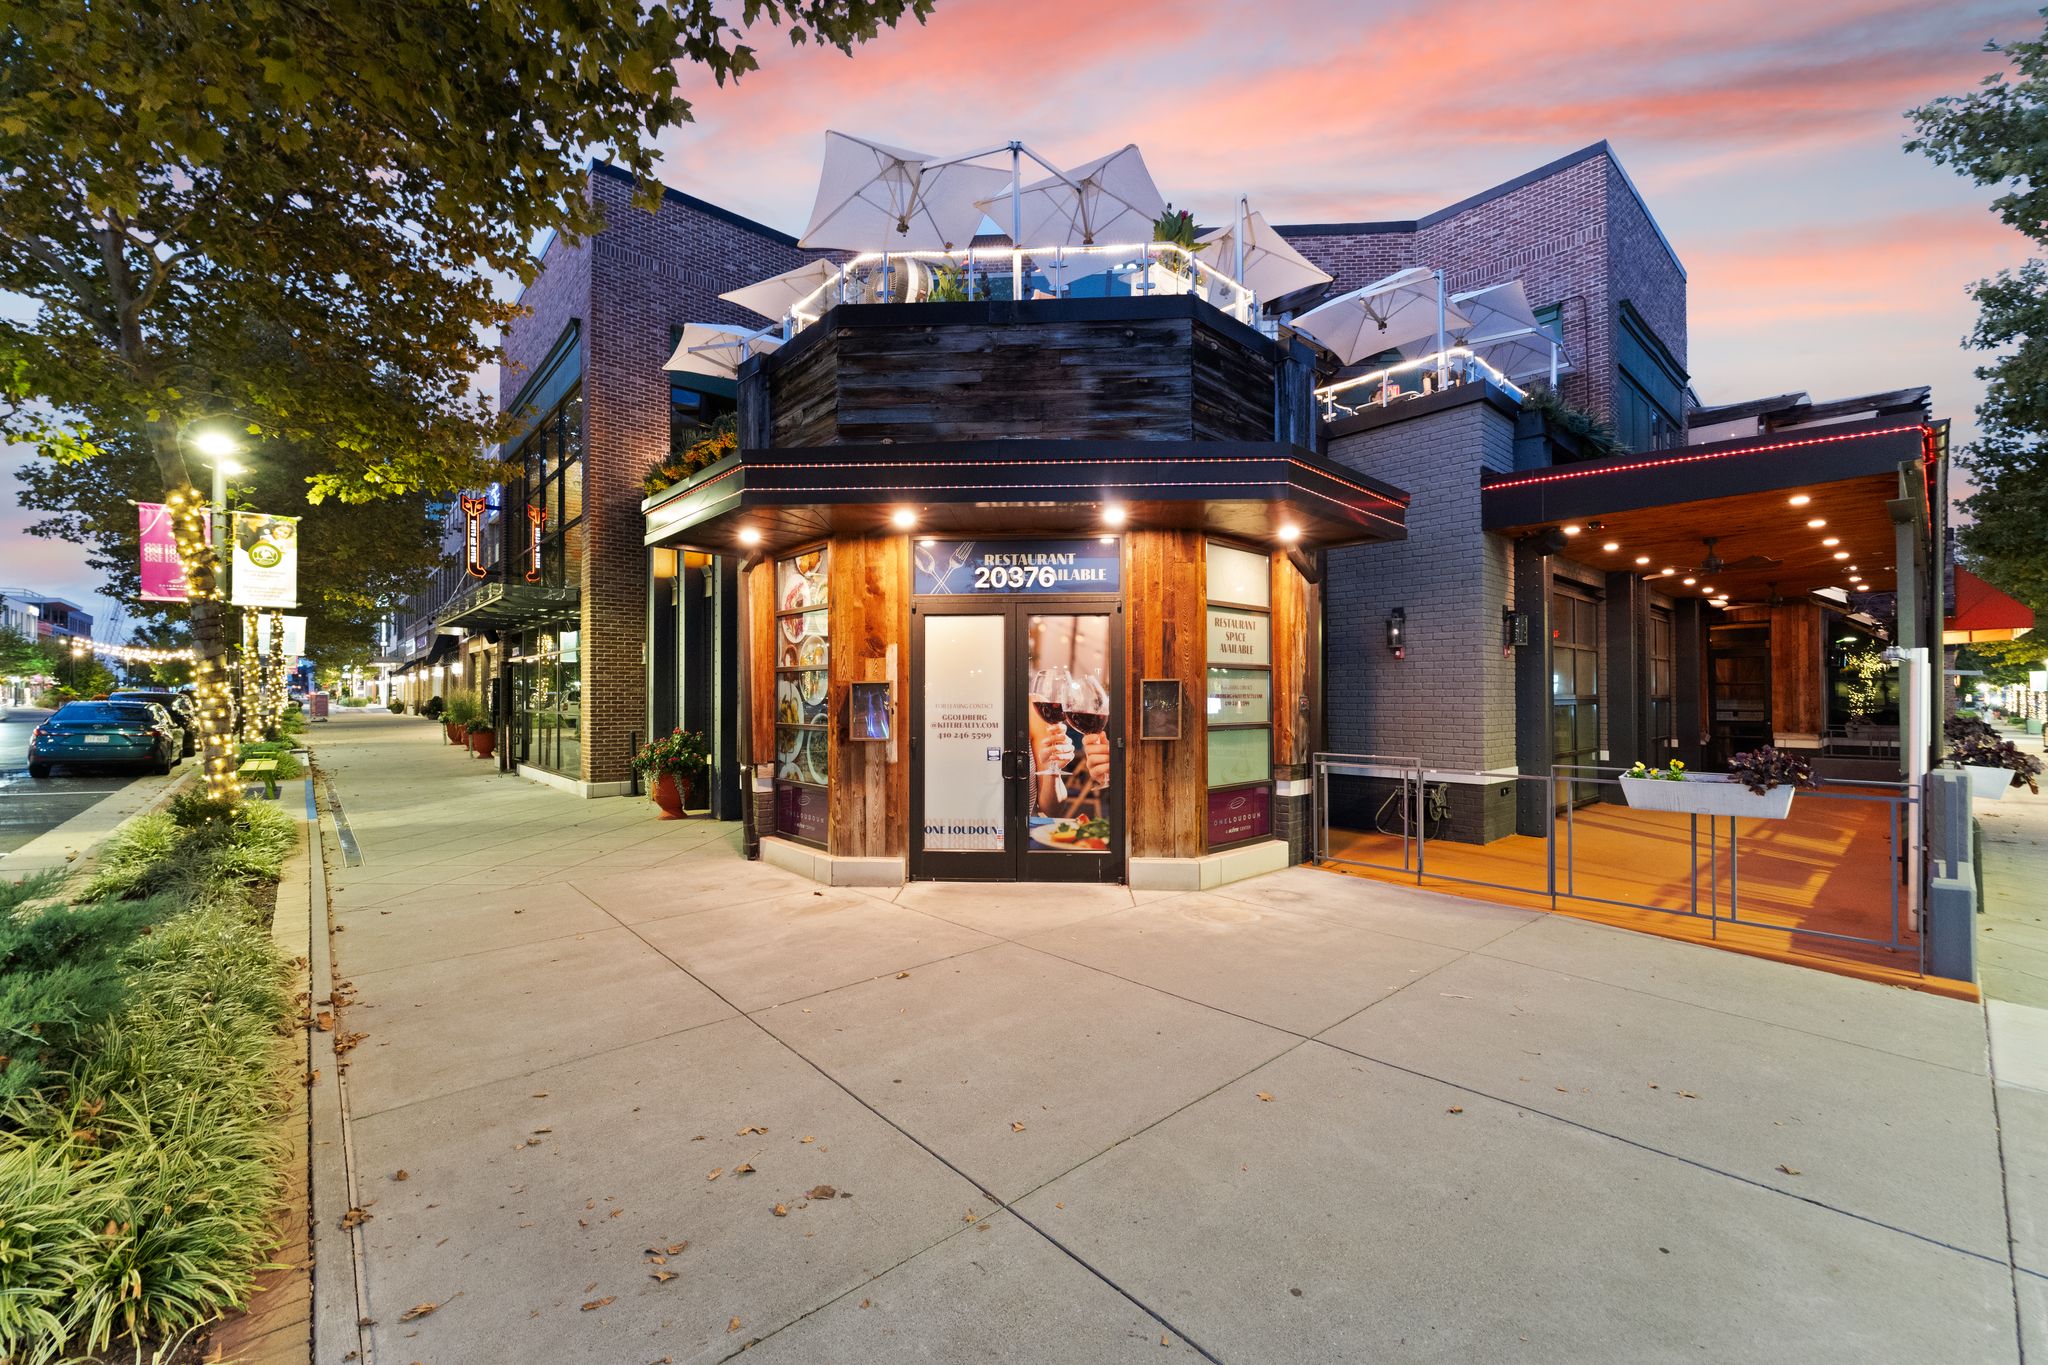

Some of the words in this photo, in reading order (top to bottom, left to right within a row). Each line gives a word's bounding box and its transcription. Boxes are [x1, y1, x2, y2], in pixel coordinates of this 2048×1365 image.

[984, 553, 1076, 566] RESTAURANT
[974, 566, 1055, 588] 20376
[1051, 568, 1107, 581] AILABLE
[1214, 617, 1256, 631] RESTAURANT
[1225, 631, 1246, 642] SPACE
[1220, 643, 1254, 655] AVAILABLE
[924, 825, 946, 835] ONE
[948, 825, 998, 835] LOUDOUN
